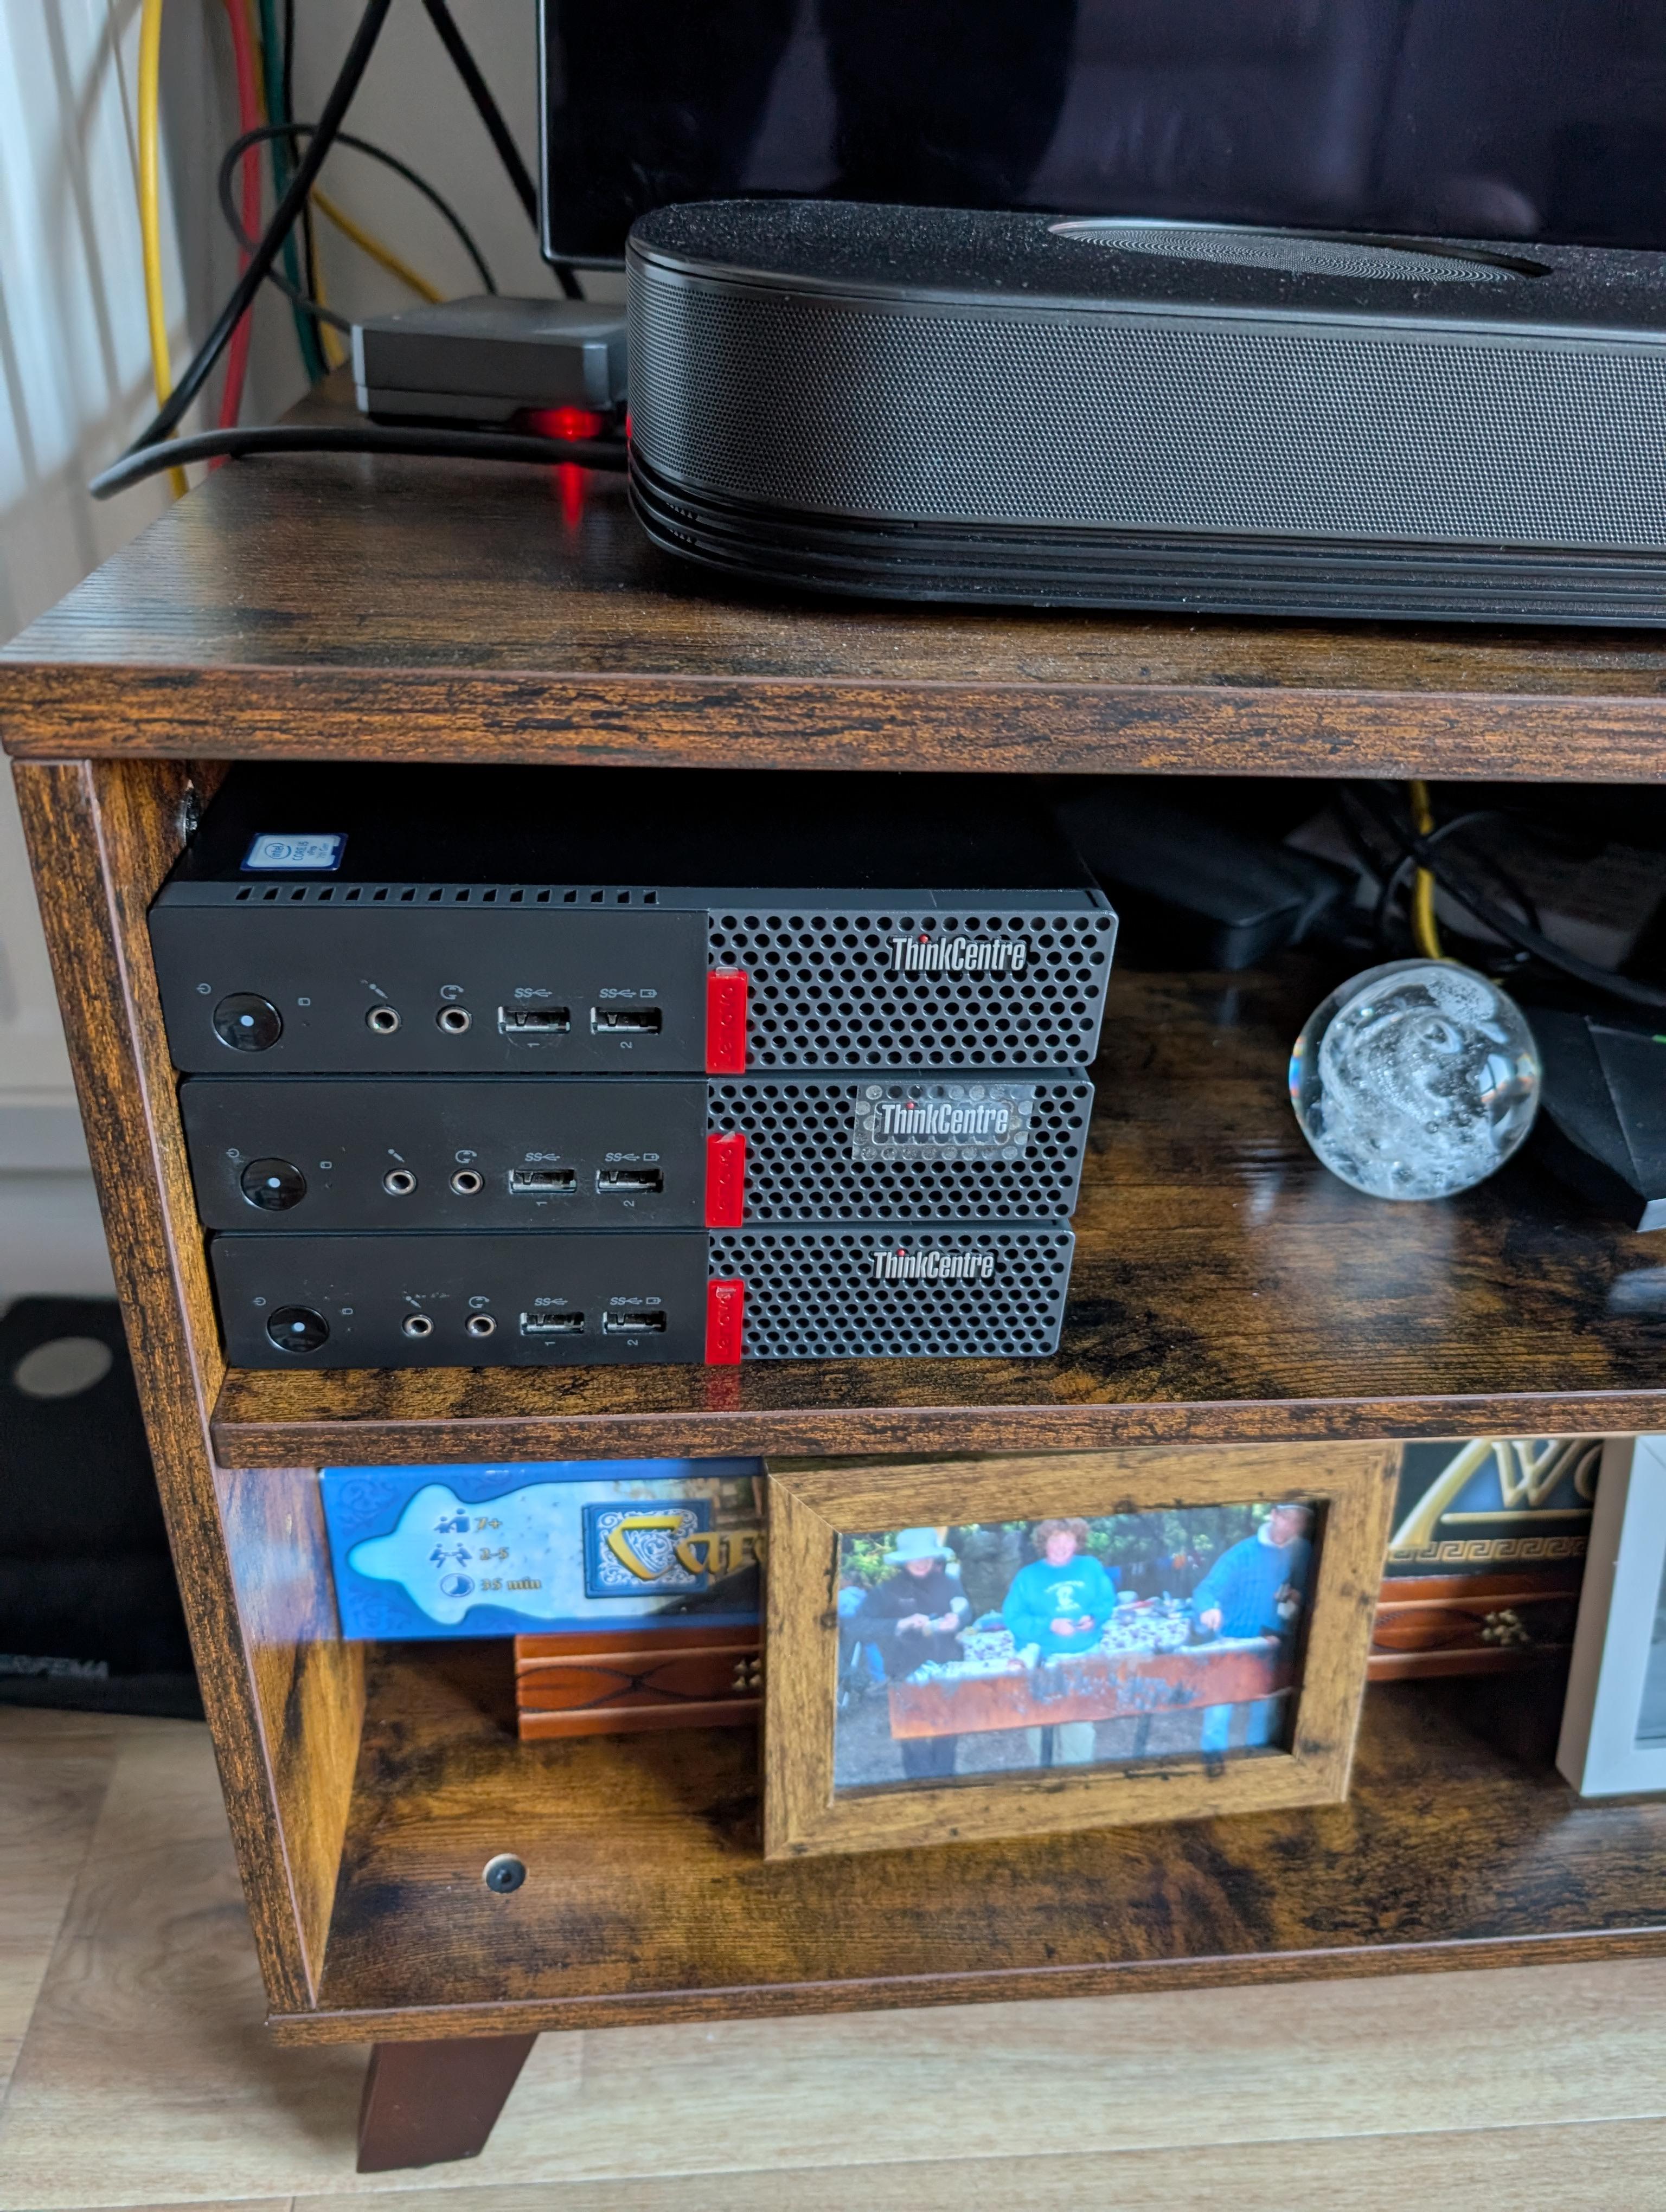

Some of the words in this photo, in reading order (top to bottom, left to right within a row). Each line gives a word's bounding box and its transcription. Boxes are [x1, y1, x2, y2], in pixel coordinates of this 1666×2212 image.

[292, 846, 307, 861] CORE
[893, 934, 1026, 970] ThinkCentre
[882, 1102, 1009, 1134] ThinkCentre
[874, 1249, 994, 1278] ThinkCentre
[474, 1516, 503, 1533] 7+
[480, 1578, 503, 1591] 35
[507, 1576, 542, 1591] min
